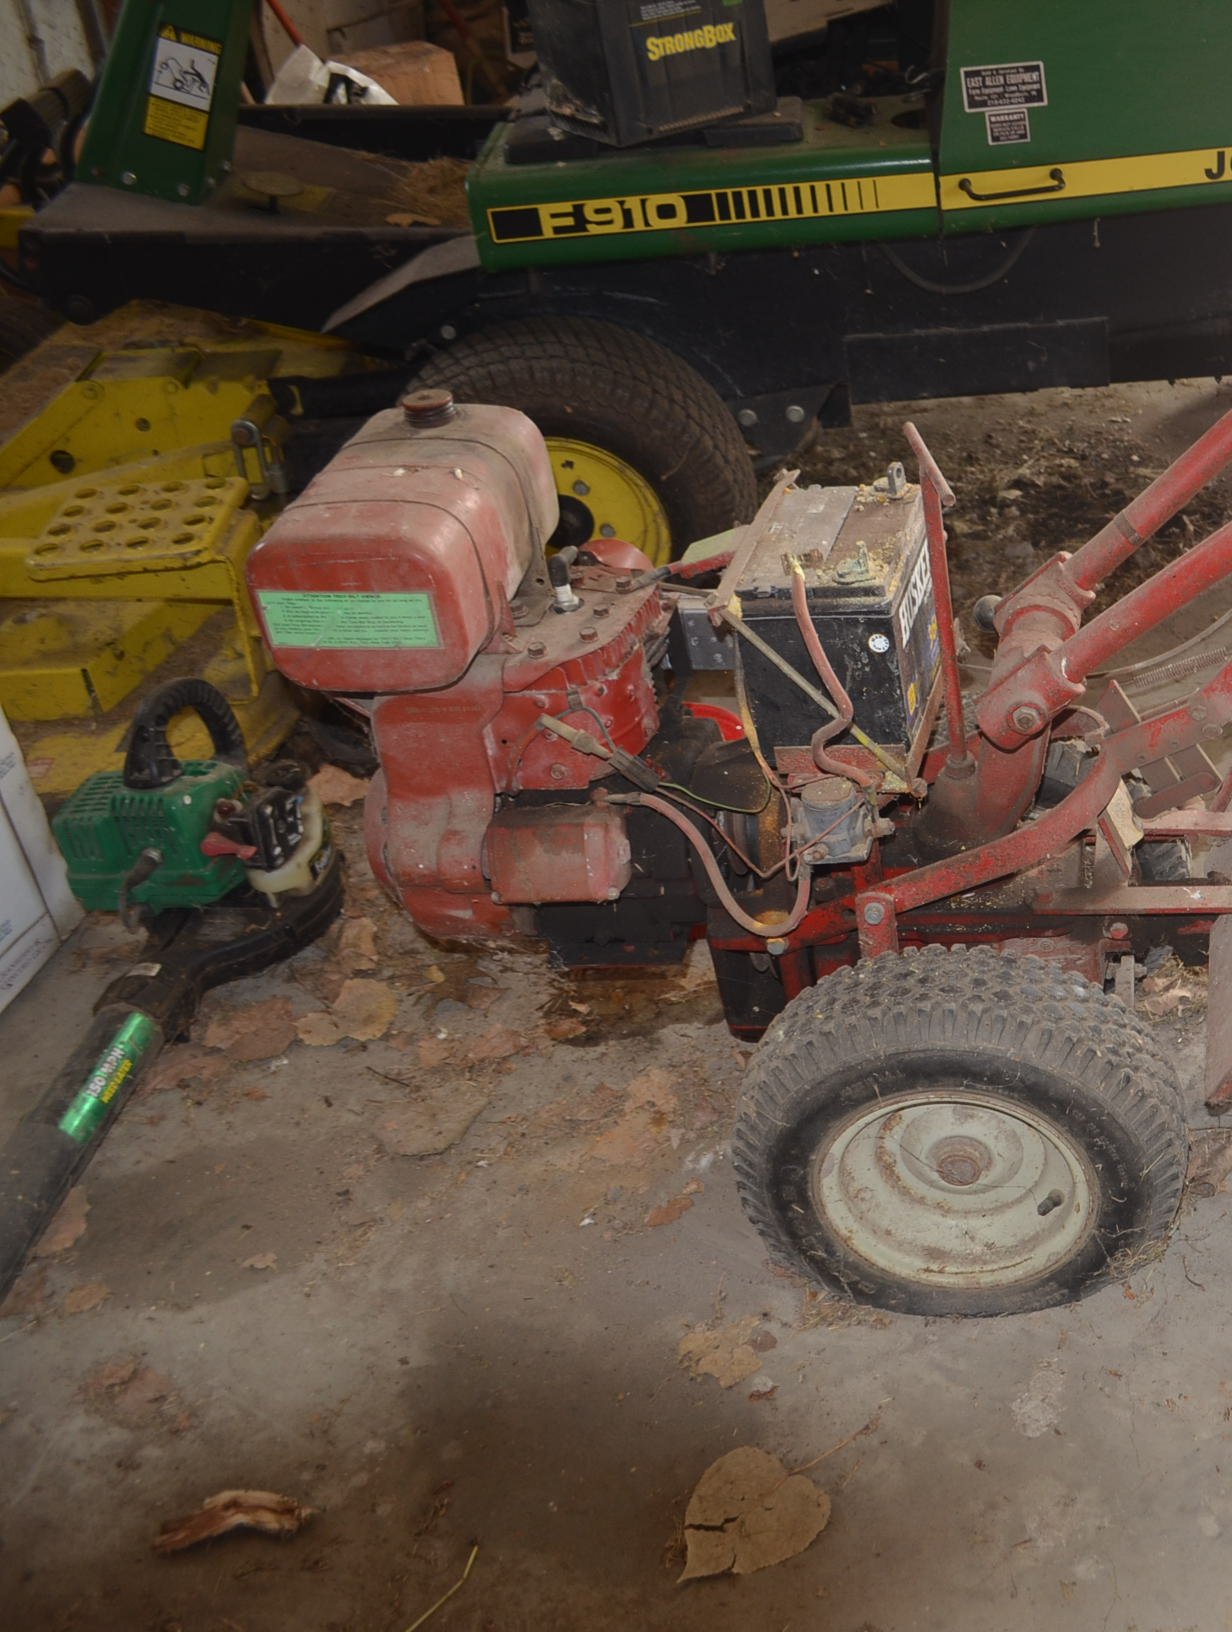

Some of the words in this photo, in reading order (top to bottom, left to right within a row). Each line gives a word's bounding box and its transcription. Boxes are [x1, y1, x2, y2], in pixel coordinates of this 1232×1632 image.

[966, 76, 983, 88] EAST
[985, 75, 1005, 86] ALLEN
[1006, 71, 1040, 85] EQUIPMENT
[538, 195, 688, 238] F910
